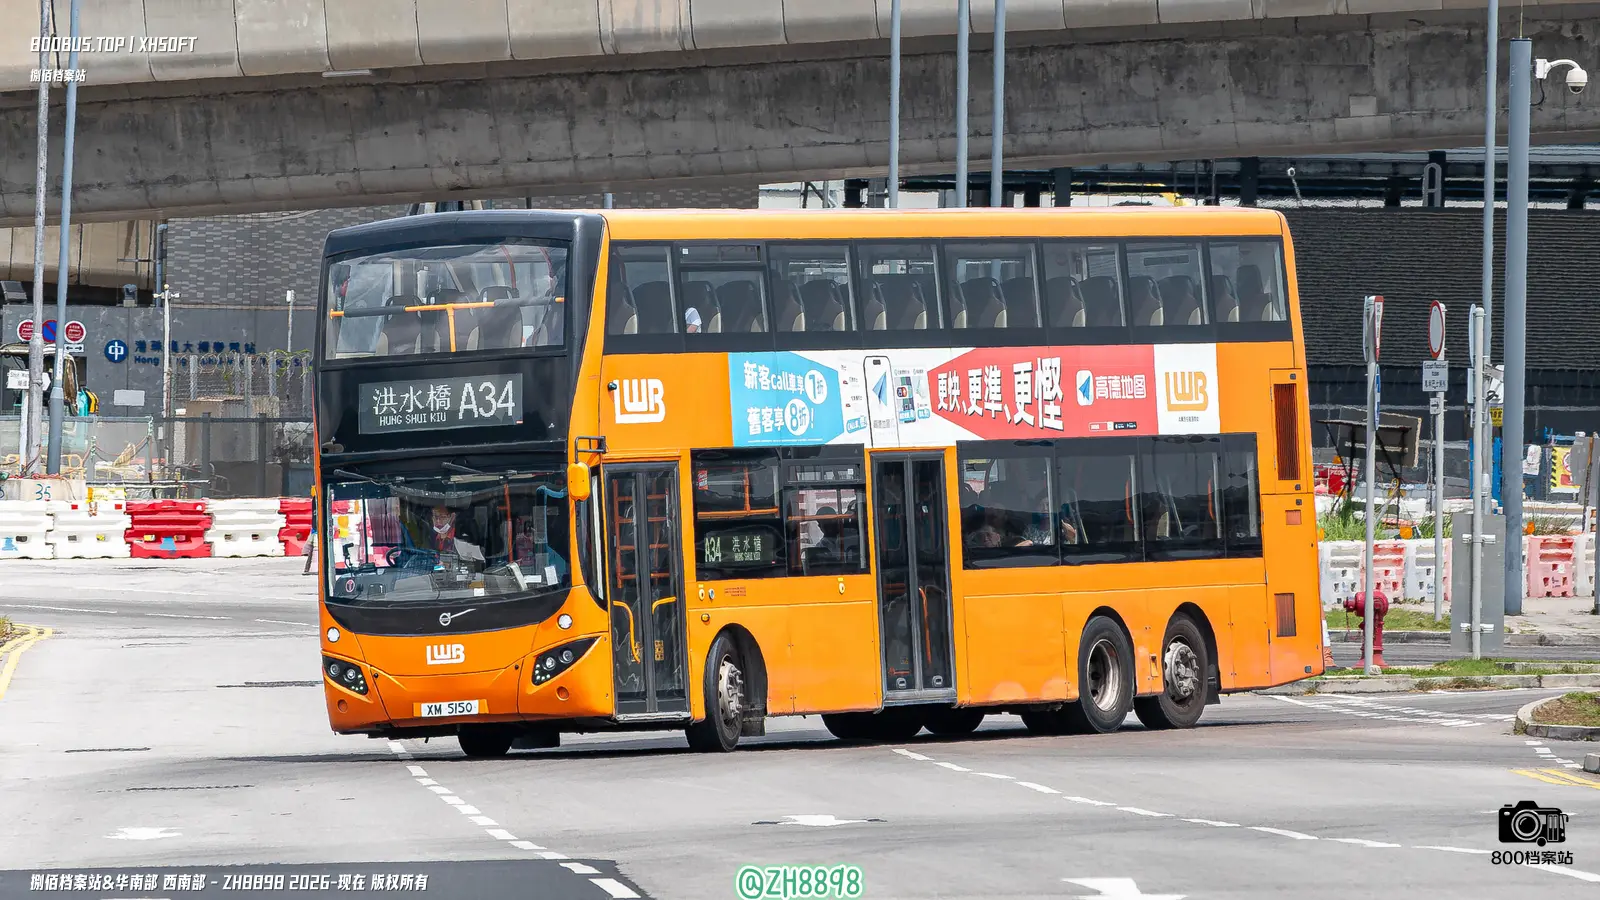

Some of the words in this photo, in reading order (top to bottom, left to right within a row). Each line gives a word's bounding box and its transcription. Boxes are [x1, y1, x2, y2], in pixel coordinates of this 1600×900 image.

[134, 355, 160, 367] Hong
[373, 384, 452, 415] 洪水橋
[458, 380, 516, 420] A34
[613, 378, 666, 425] LWB
[1164, 371, 1209, 412] LWB
[379, 414, 403, 427] HUNG
[405, 413, 427, 425] SHUI
[430, 411, 447, 423] KIU
[704, 536, 722, 563] A34
[731, 535, 762, 553] 洪水橋
[426, 643, 465, 665] LWB
[426, 703, 442, 716] XM
[447, 702, 473, 715] 5150
